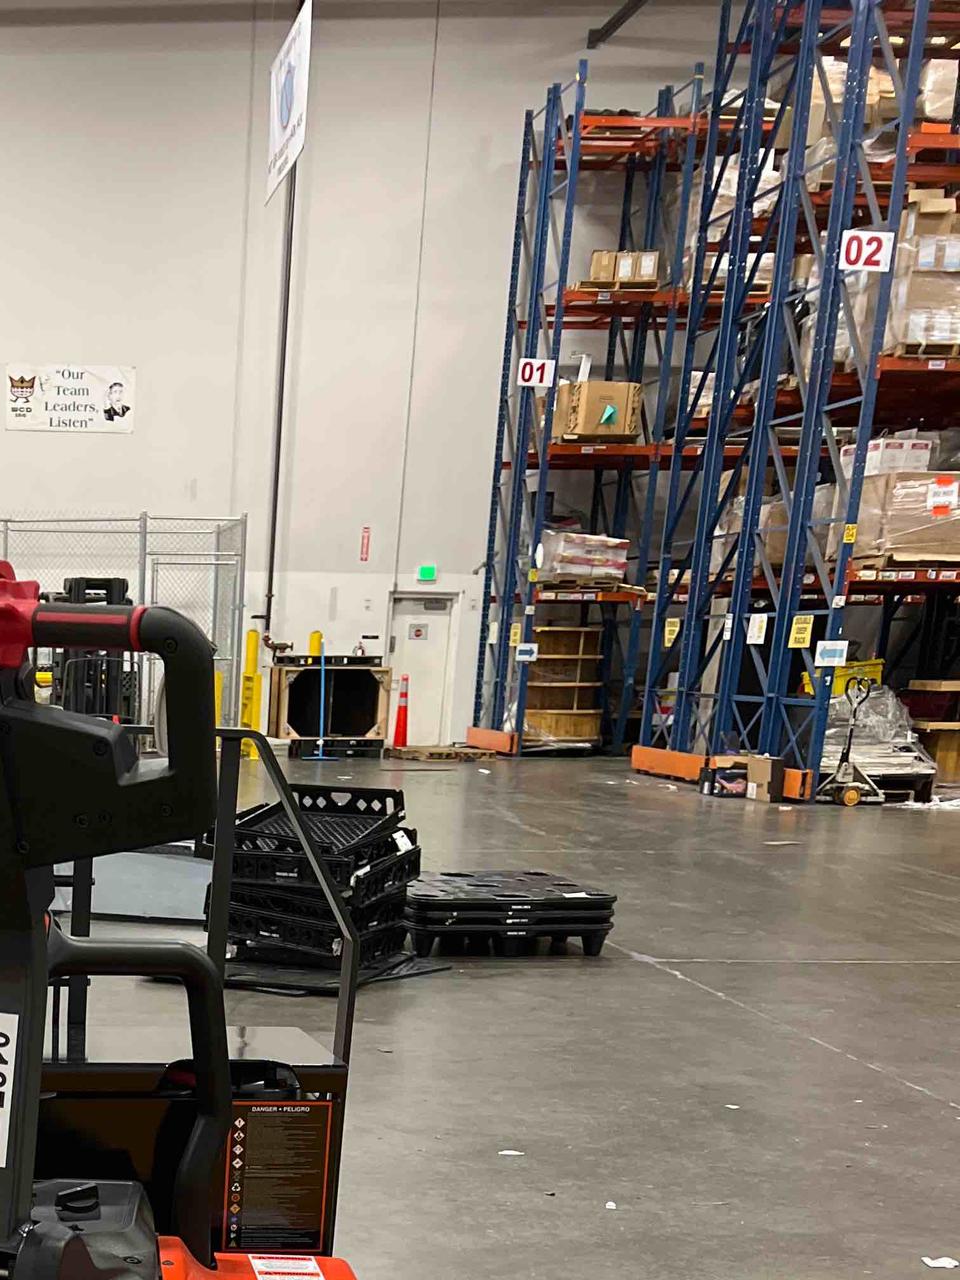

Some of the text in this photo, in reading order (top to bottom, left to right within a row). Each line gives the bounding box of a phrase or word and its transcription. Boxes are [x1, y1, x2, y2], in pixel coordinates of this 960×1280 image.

[845, 235, 883, 266] 02
[521, 361, 546, 383] 01
[54, 385, 90, 396] Team
[44, 401, 100, 413] Leaders,
